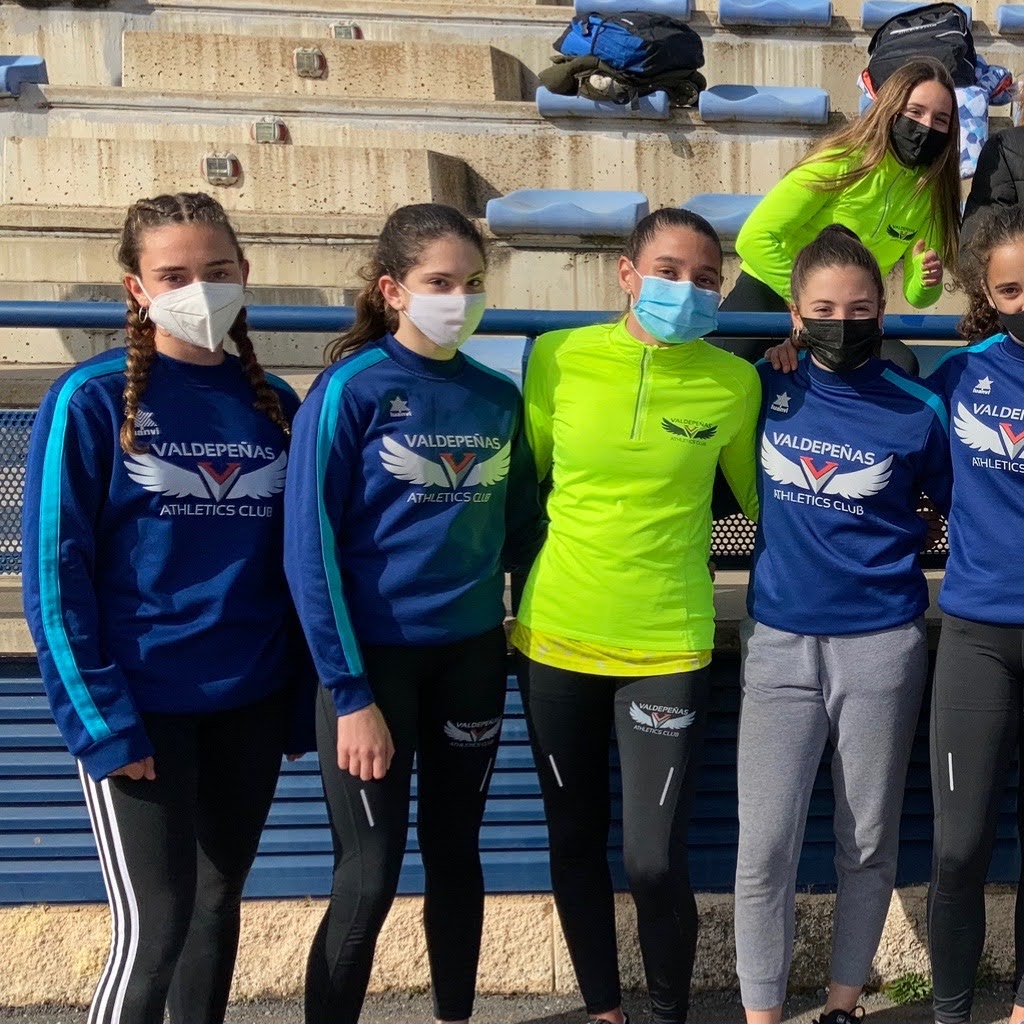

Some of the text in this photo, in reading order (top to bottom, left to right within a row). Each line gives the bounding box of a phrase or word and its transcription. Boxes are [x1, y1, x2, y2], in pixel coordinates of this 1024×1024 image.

[404, 433, 501, 450] VALDEPEÑAS
[773, 432, 876, 465] VALDEPEÑAS
[152, 441, 276, 460] VALDEPEÑAS
[406, 492, 472, 504] ATHLETICS
[774, 489, 864, 516] ATHLETICS CLUB
[160, 504, 273, 518] ATHLETICS CLUB
[640, 702, 689, 715] VALDEPEÑAS
[634, 724, 680, 738] ATHLETICS CLUB
